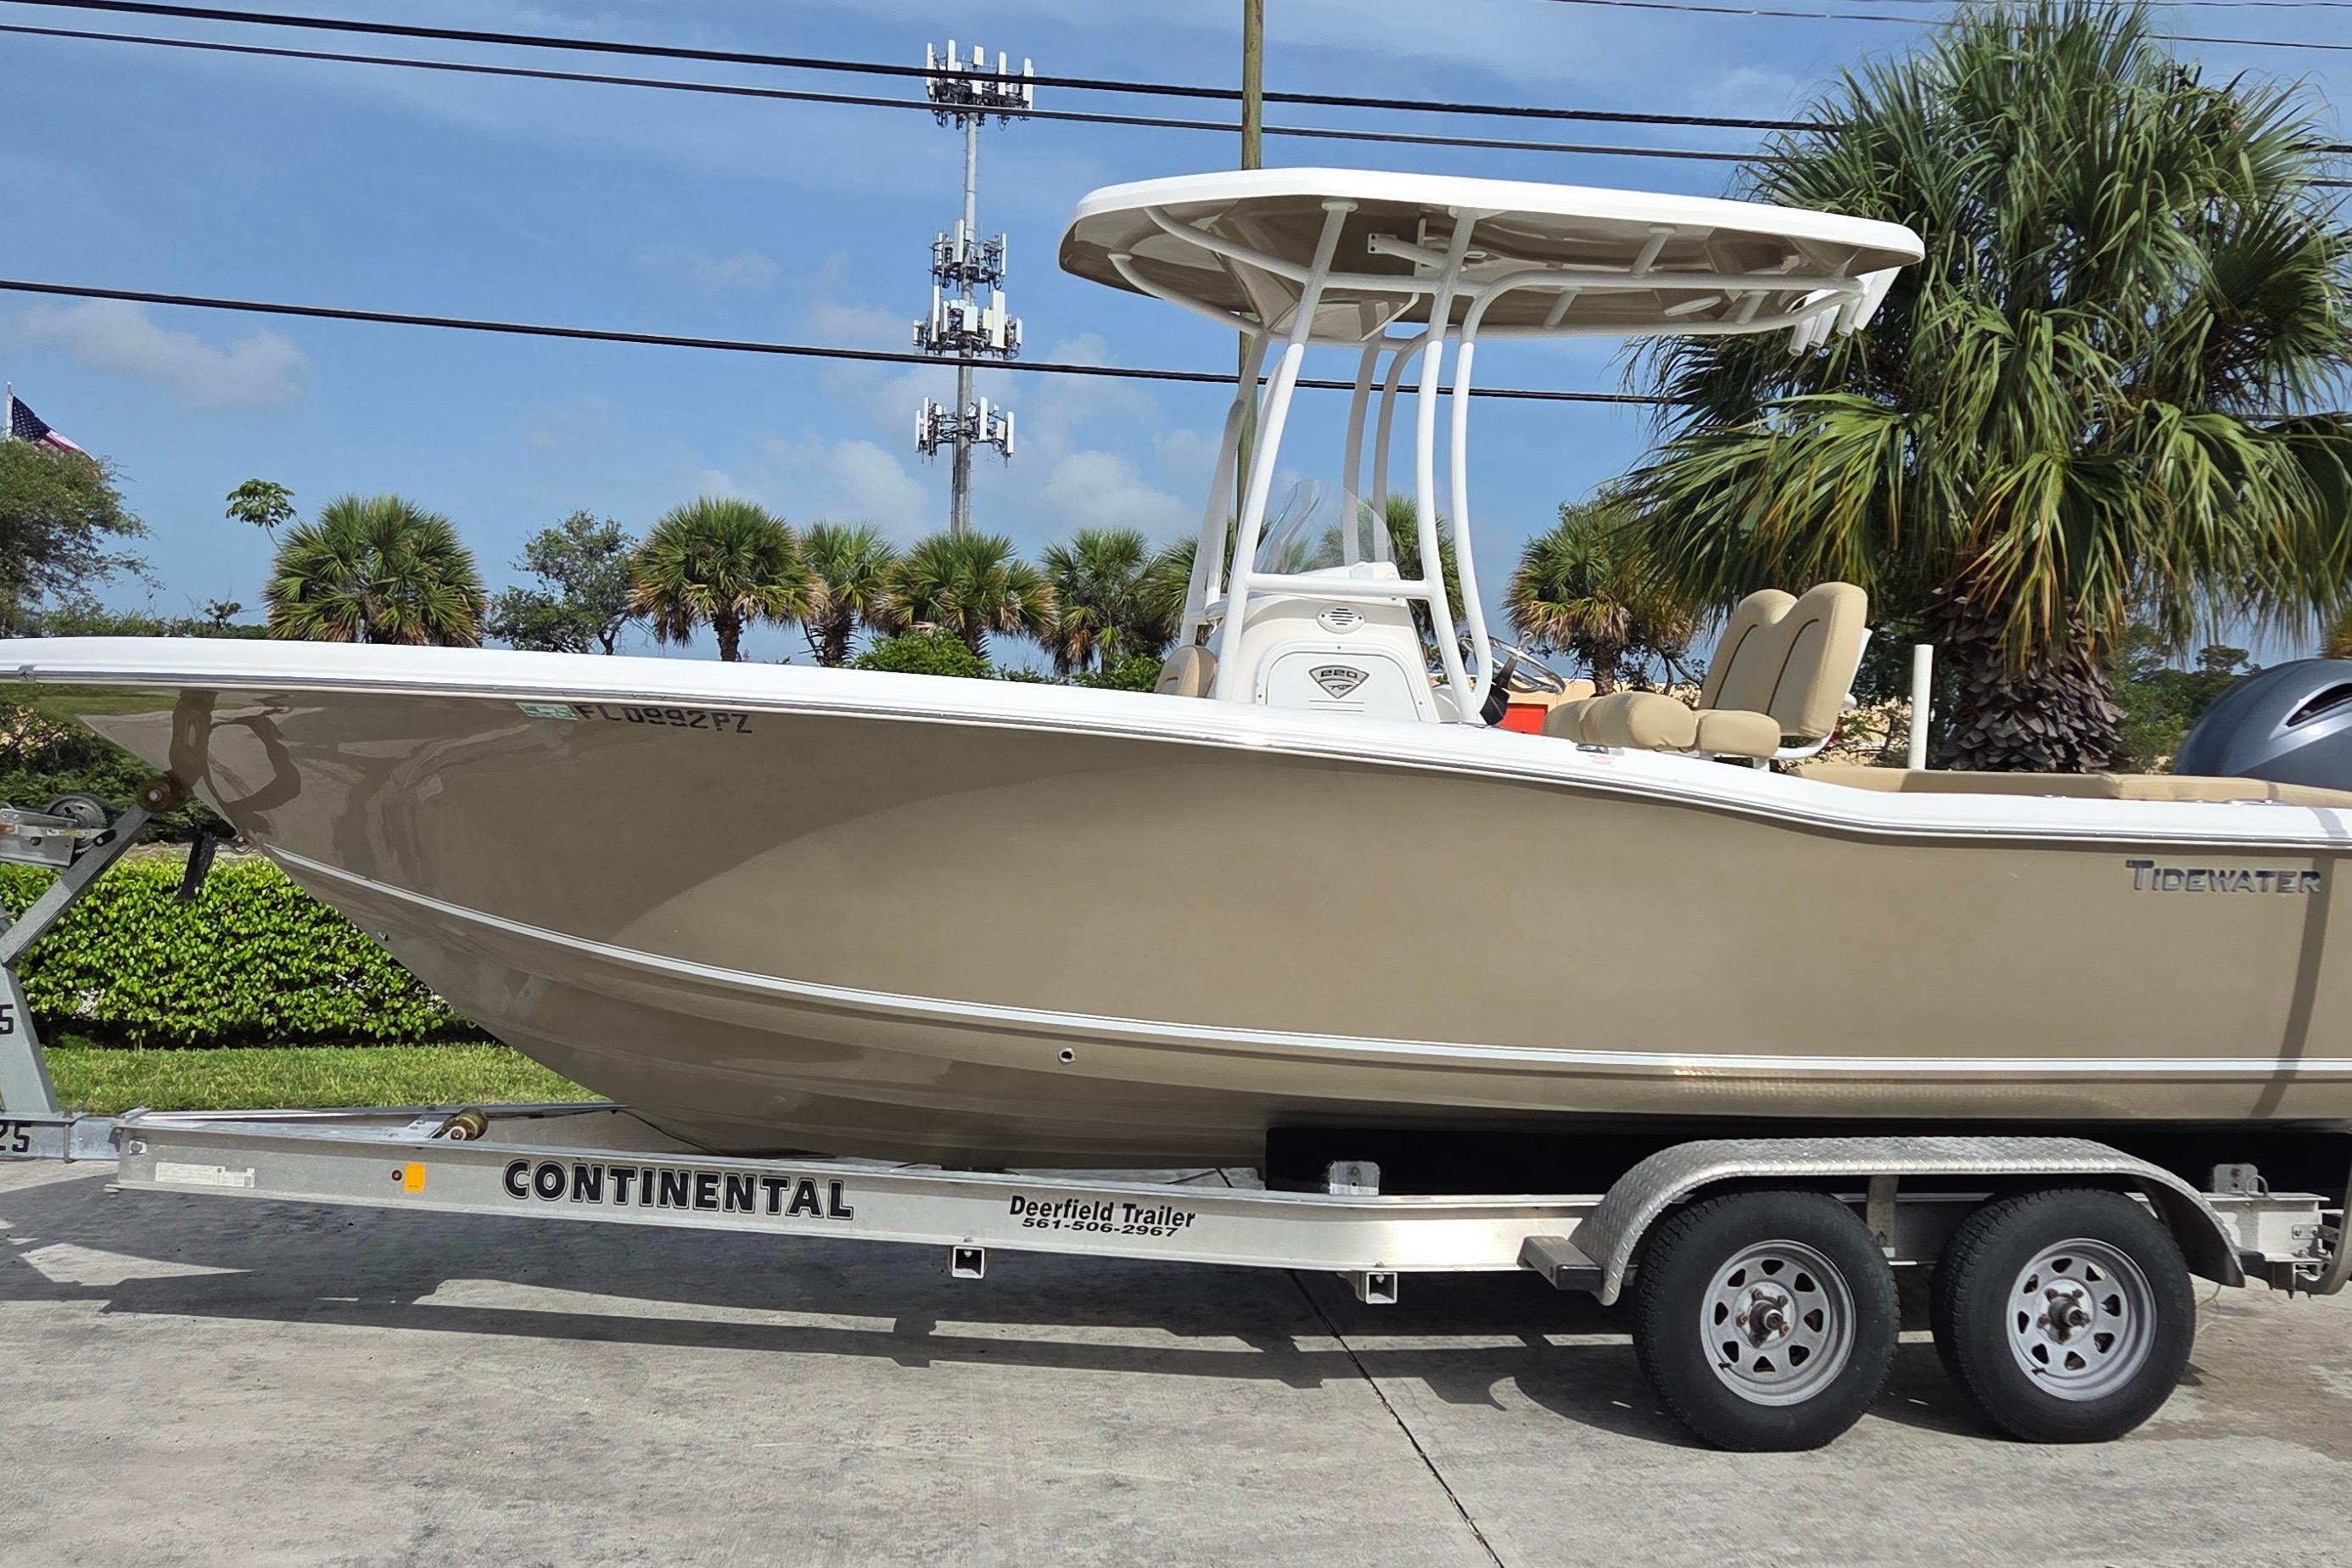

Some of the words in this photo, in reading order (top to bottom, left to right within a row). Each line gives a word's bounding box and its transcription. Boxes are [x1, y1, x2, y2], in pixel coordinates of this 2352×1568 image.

[2125, 860, 2321, 893] TIDEWATER
[502, 1159, 854, 1221] CONTINENTAL
[1009, 1195, 1115, 1222] Deerfield
[1122, 1202, 1196, 1228] Trailer
[1022, 1217, 1179, 1237] 561-506-2967
